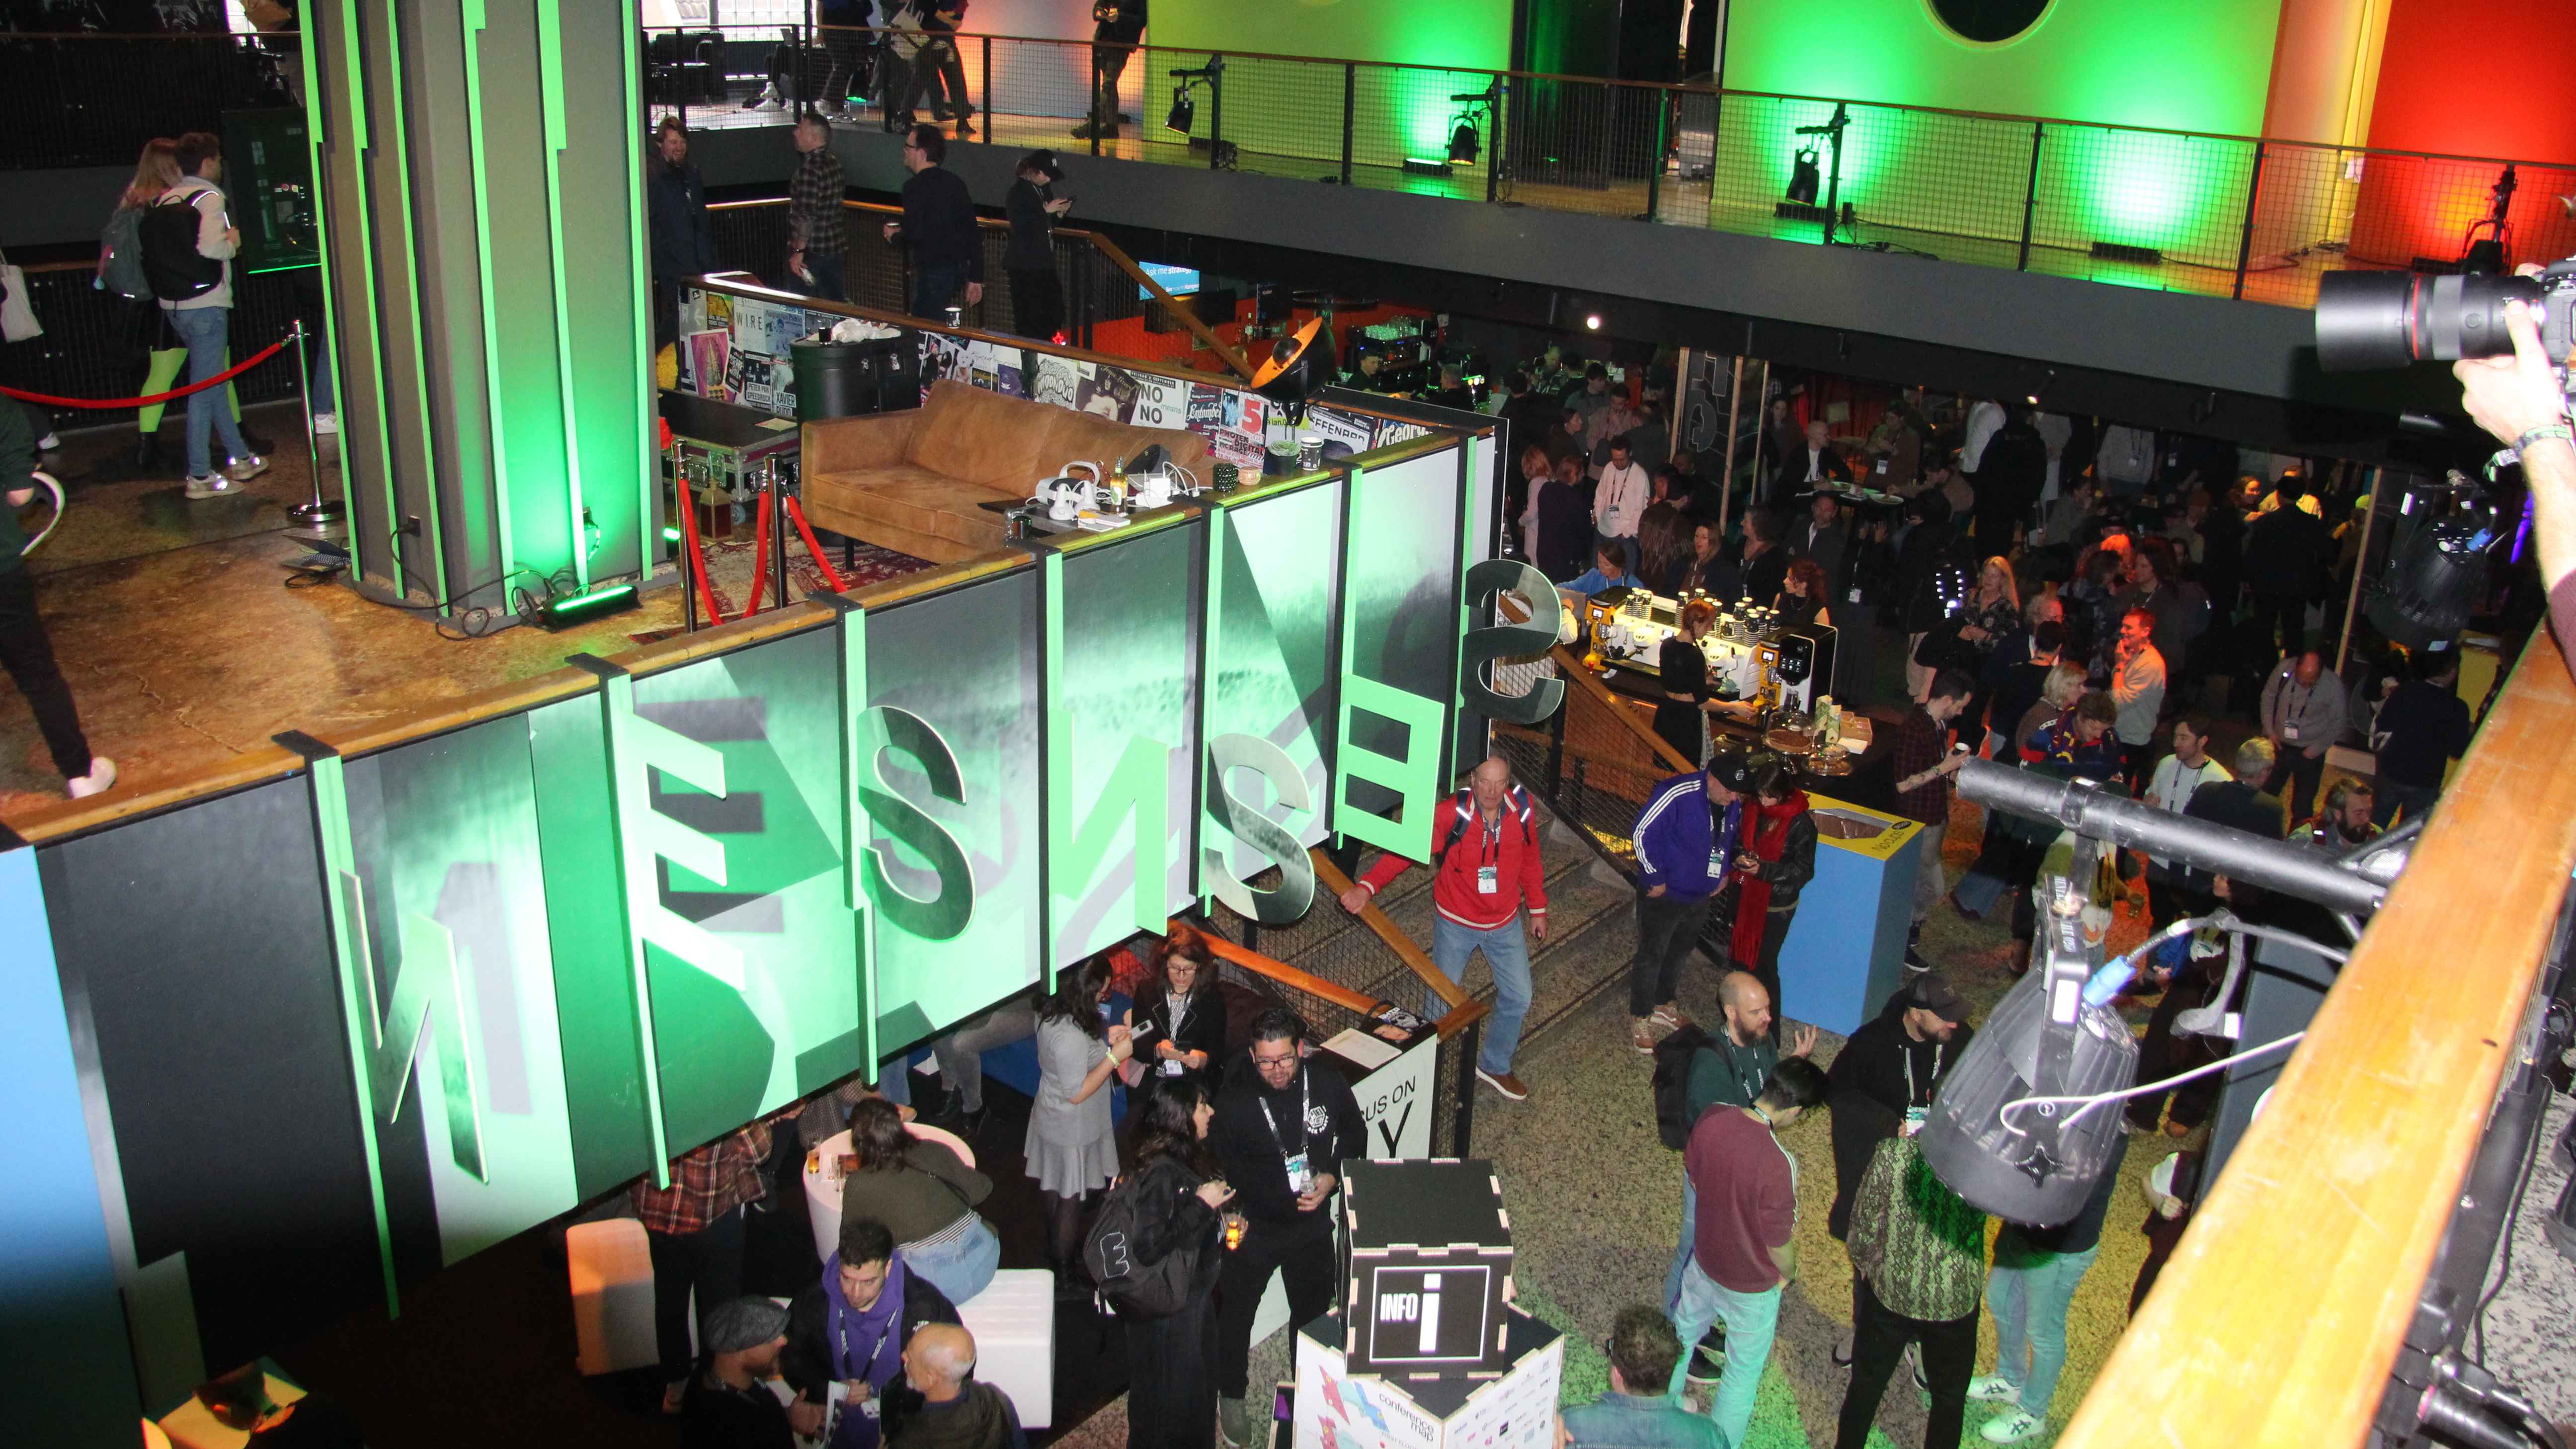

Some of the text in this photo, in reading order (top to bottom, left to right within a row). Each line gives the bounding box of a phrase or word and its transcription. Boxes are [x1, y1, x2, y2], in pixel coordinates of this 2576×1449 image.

[1146, 267, 1157, 276] Ask
[736, 313, 763, 330] WIRE
[776, 392, 796, 406] XAVIER
[1141, 383, 1163, 403] NO
[1140, 404, 1163, 423] NO
[1161, 404, 1182, 414] means
[1242, 398, 1261, 434] 5
[1234, 438, 1265, 456] DIGITAL
[1392, 1075, 1416, 1104] ON
[1100, 1231, 1130, 1279] E
[1380, 1292, 1419, 1321] INFO
[1379, 1393, 1435, 1433] conference
[1410, 1422, 1434, 1442] map
